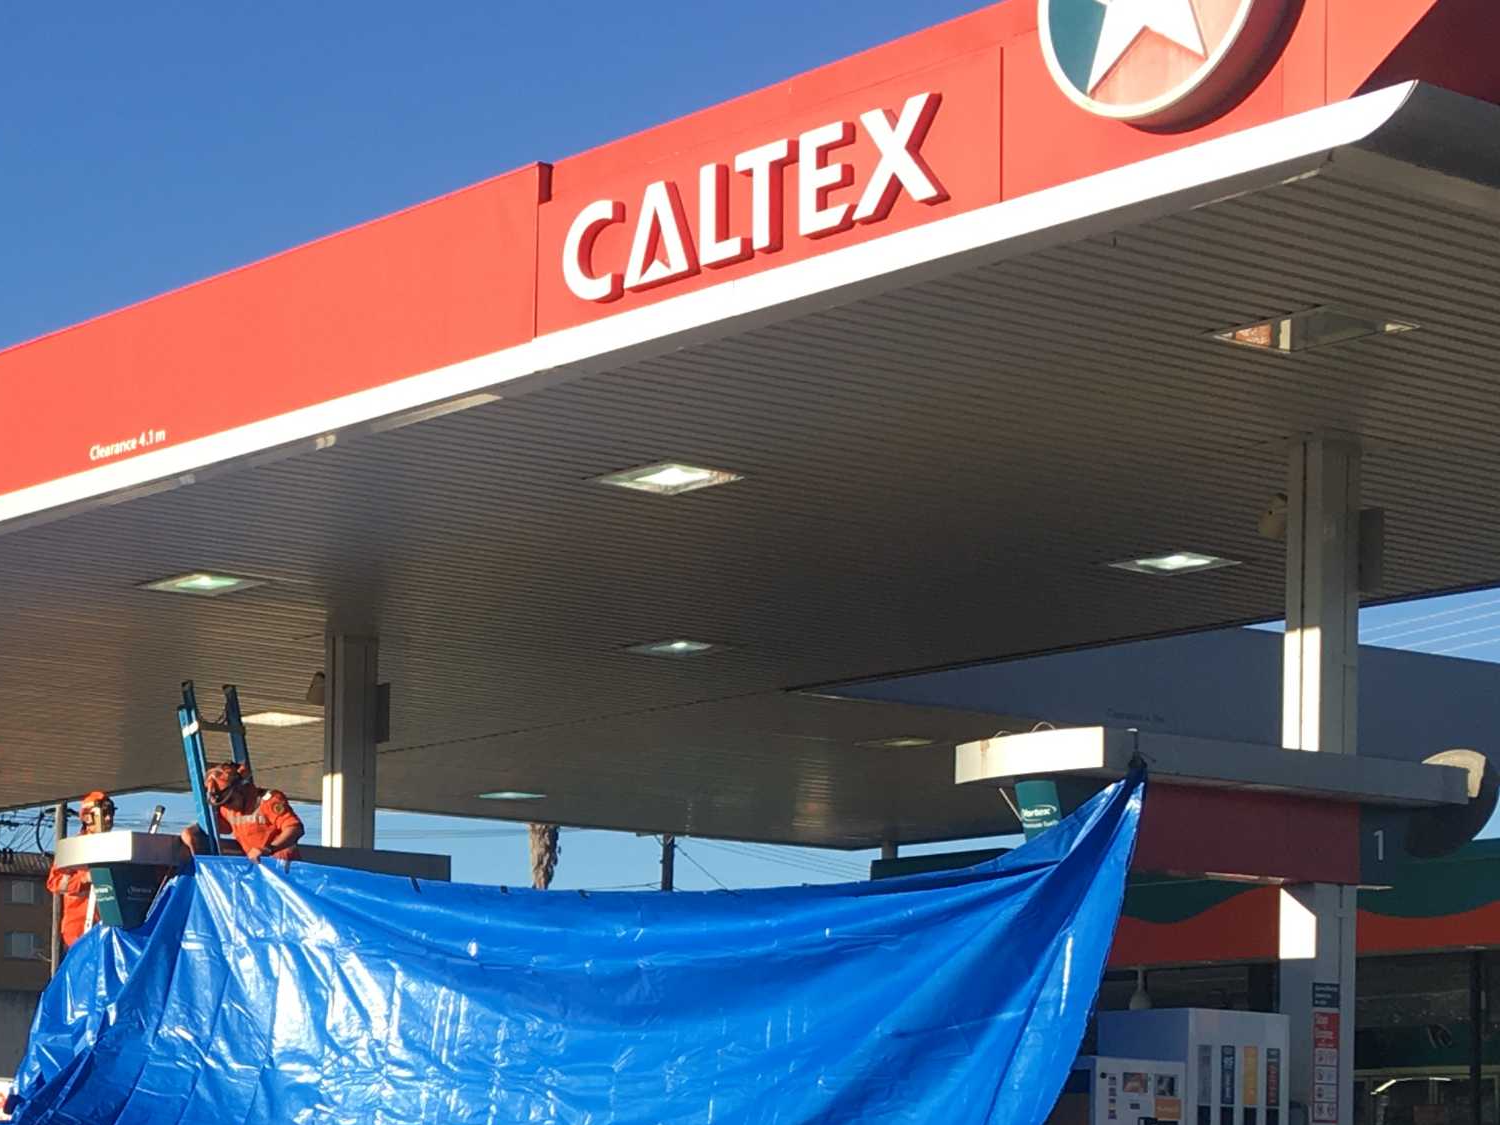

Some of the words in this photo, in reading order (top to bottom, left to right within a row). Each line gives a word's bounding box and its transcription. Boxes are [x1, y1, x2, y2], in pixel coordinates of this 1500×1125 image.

[562, 92, 946, 302] CALTEX
[89, 436, 137, 460] Clearance
[1373, 829, 1384, 861] 1
